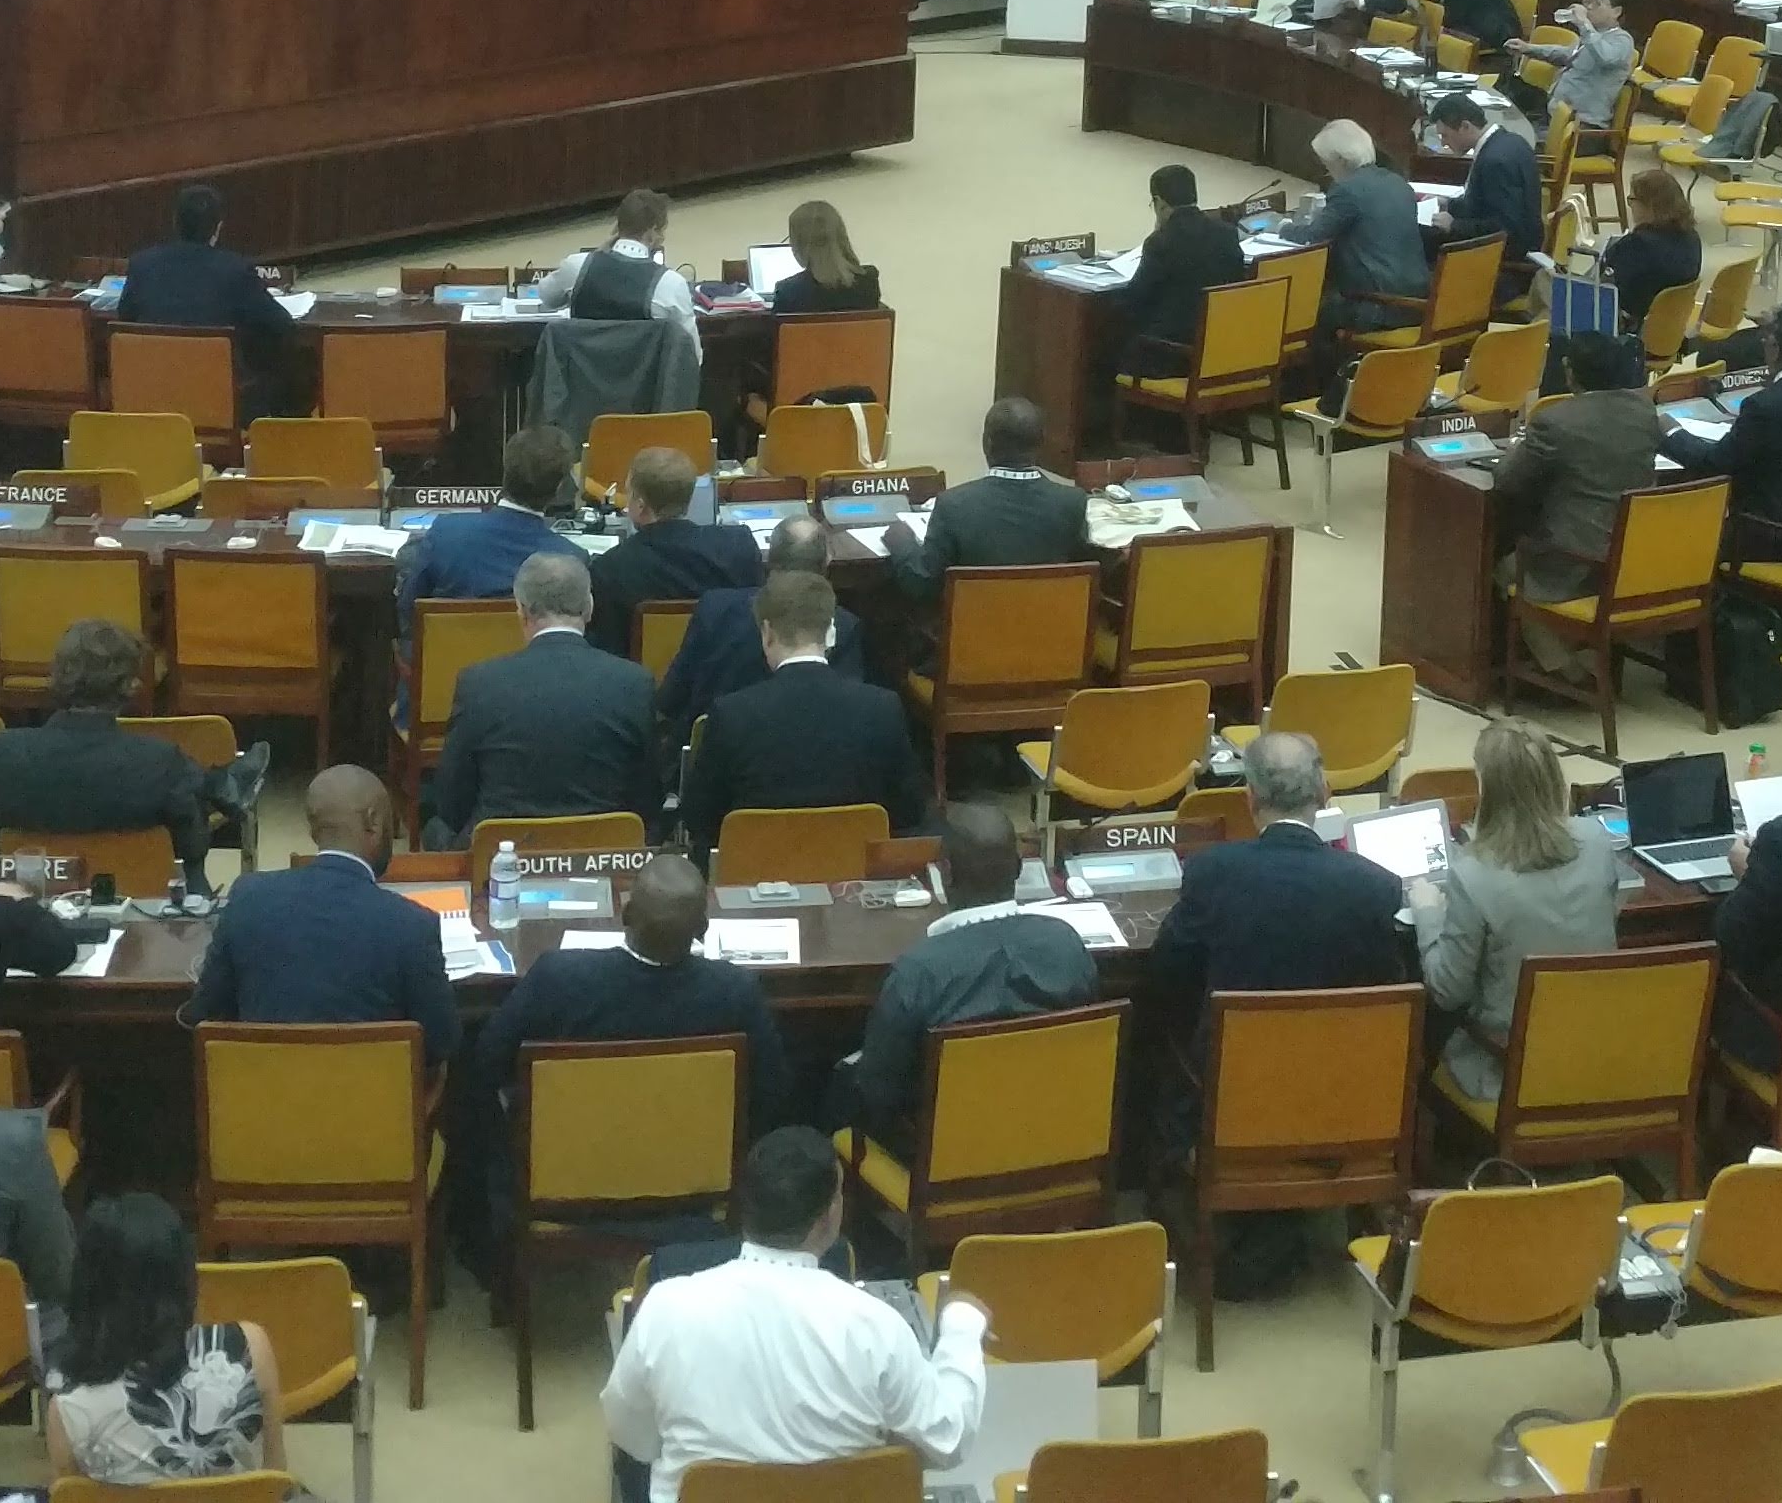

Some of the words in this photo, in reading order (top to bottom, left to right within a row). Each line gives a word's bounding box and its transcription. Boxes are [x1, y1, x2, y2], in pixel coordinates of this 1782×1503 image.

[1441, 416, 1477, 434] INDIA
[852, 477, 910, 495] GHANA
[415, 488, 502, 505] GERMANY
[1106, 825, 1176, 848] SPAIN
[519, 856, 572, 874] OUTH
